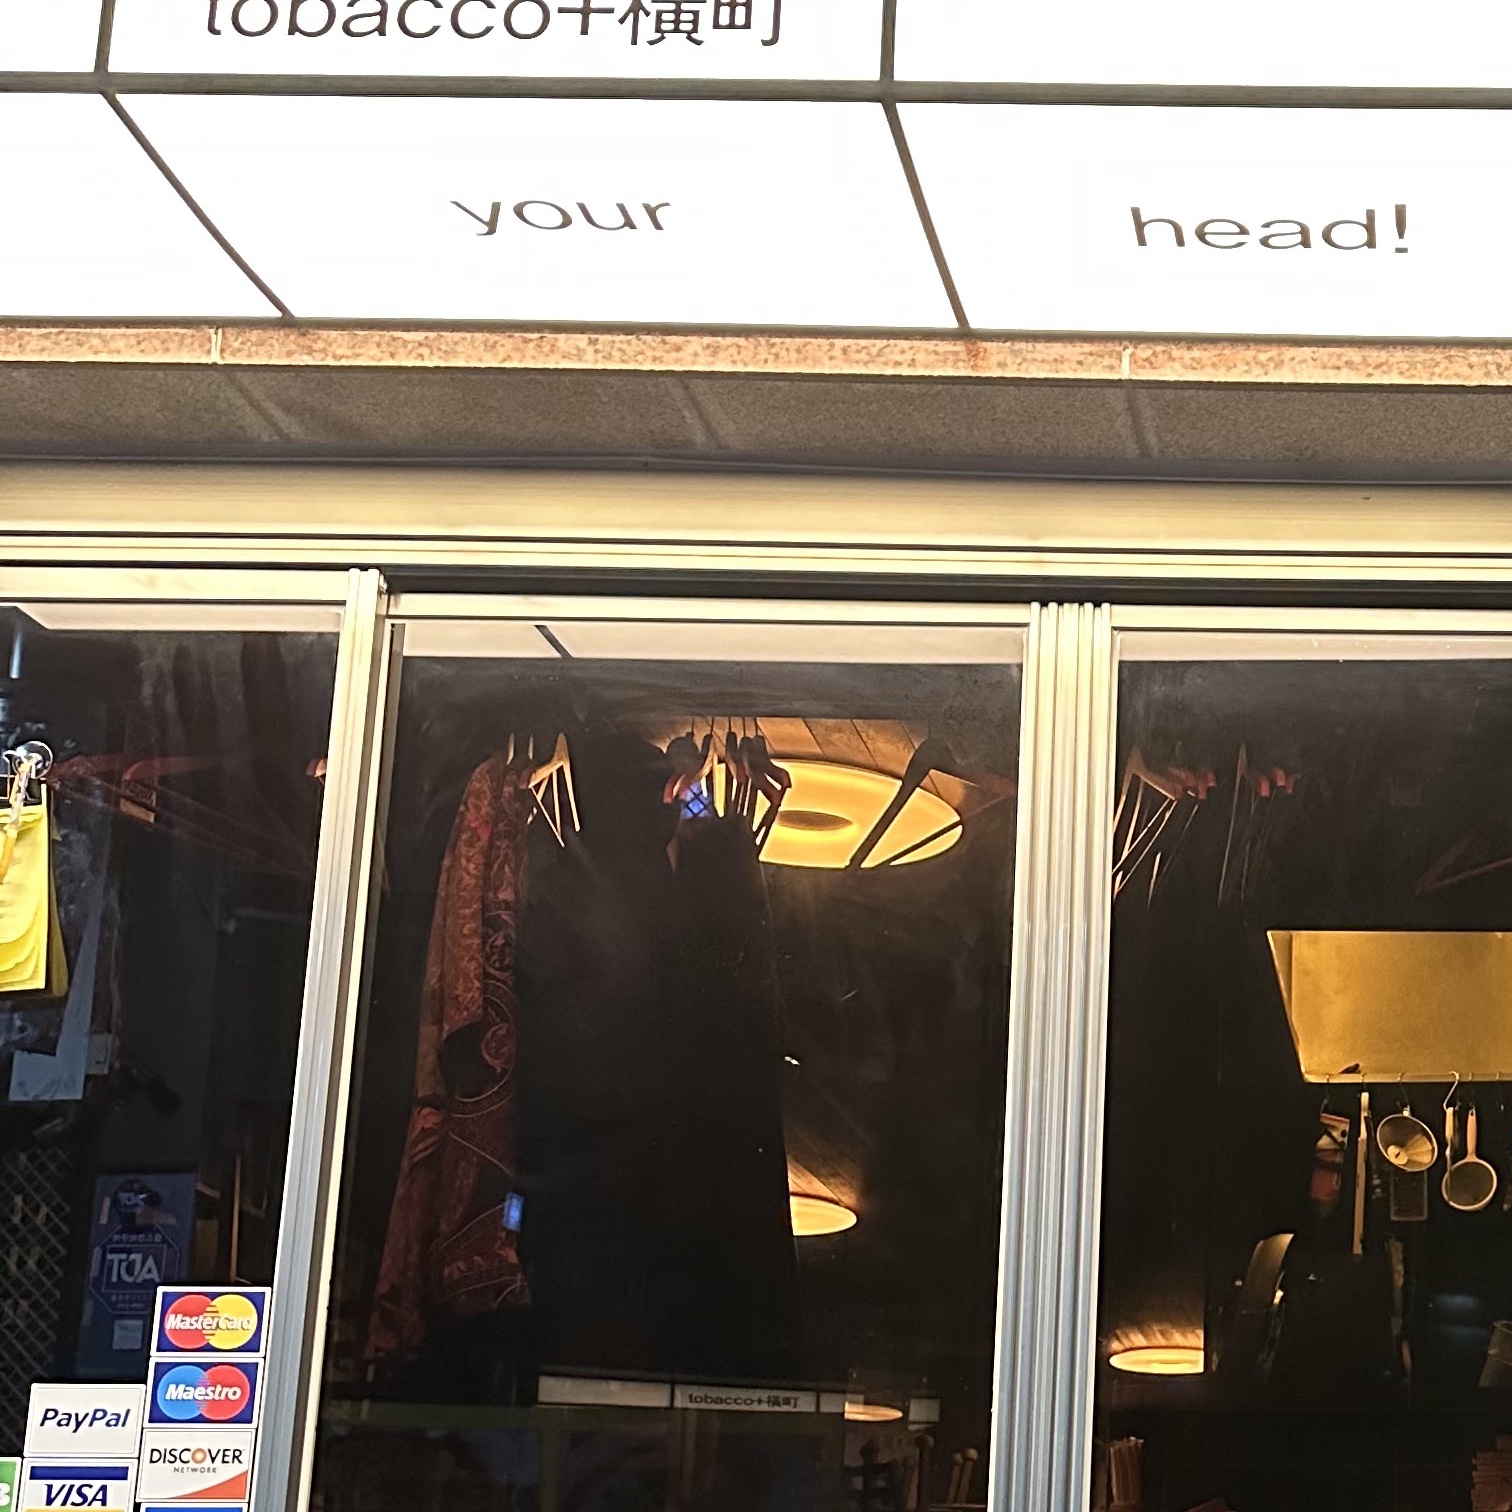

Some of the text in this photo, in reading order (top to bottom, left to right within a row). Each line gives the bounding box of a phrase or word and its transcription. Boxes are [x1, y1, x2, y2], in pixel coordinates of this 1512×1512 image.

[449, 200, 671, 237] your
[1129, 204, 1409, 254] head!
[166, 1313, 254, 1330] MasterCard
[165, 1384, 242, 1401] Maestro
[39, 1408, 131, 1434] PayPal
[149, 1448, 243, 1465] DISCOVER
[173, 1466, 217, 1474] NETWORK
[45, 1483, 108, 1507] VISA
